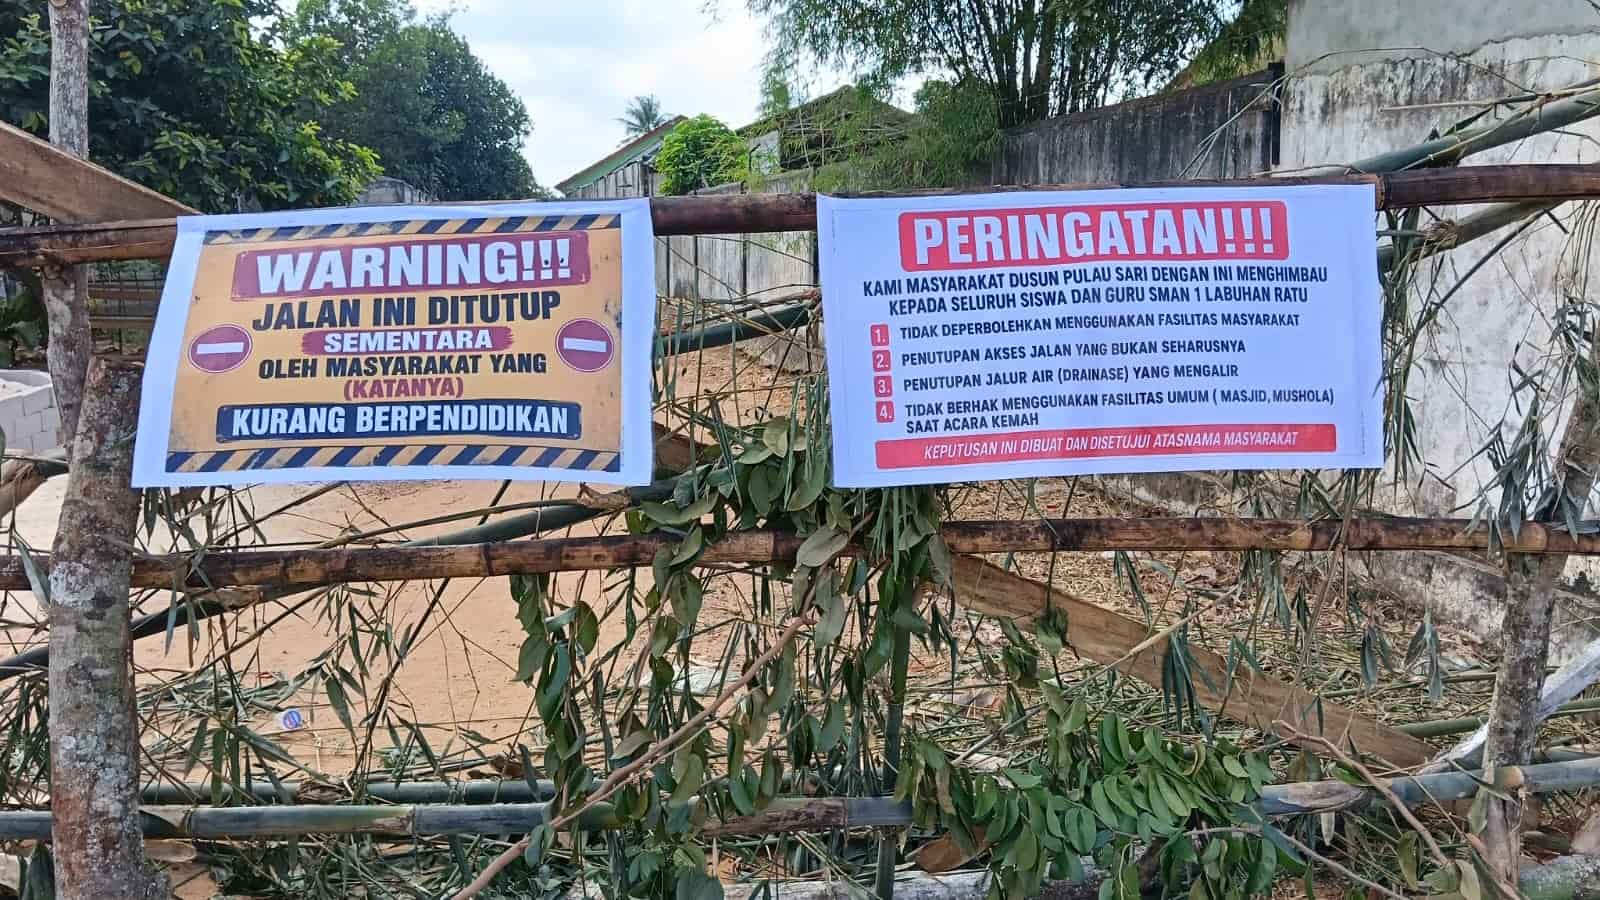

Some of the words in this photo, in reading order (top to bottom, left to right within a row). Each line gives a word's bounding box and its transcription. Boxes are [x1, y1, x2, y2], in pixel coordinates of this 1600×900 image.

[914, 207, 1274, 265] PERINGATAN!!!
[257, 238, 571, 294] WARNING!!!
[863, 279, 902, 296] KAMI
[906, 273, 1005, 294] MASYARAKAT
[1009, 270, 1059, 288] DUSUN
[1063, 266, 1111, 285] PULAU
[1115, 266, 1148, 282] SARI
[1151, 266, 1209, 282] DENGAN
[1213, 265, 1232, 281] INI
[1236, 266, 1327, 283] MENGHIMBAU
[252, 299, 361, 331] JALAN
[373, 296, 415, 326] INI
[429, 291, 560, 323] DITUTUP
[889, 297, 948, 316] KEPADA
[951, 293, 1017, 312] SELURUH
[1020, 290, 1067, 308] SISWA
[1072, 288, 1100, 303] DAN
[1105, 287, 1145, 303] GURU
[1148, 286, 1190, 302] SMAN
[1194, 286, 1200, 301] 1
[1205, 286, 1269, 301] LABUHAN
[1273, 286, 1308, 303] RATU
[324, 330, 492, 352] SEMENTARA
[875, 329, 886, 343] 1.
[900, 325, 938, 339] TIDAK
[941, 318, 1052, 336] DEPERBOLEHKAN
[1055, 314, 1155, 330] MENGGUNAKAN
[1158, 312, 1217, 327] FASILITAS
[1221, 312, 1299, 327] MASYARAKAT
[259, 358, 317, 379] OLEH
[326, 356, 480, 377] MASYARAKAT
[491, 353, 546, 373] YANG
[876, 354, 888, 369] 2.
[902, 349, 980, 367] PENUTUPAN
[985, 345, 1026, 362] AKSES
[1030, 343, 1072, 359] JALAN
[1076, 342, 1107, 357] YANG
[1112, 340, 1158, 355] BUKAN
[1162, 339, 1245, 354] SEHARUSNYA
[344, 377, 464, 401] (KATANYA)
[877, 379, 891, 394] 3.
[903, 374, 981, 392] PENUTUPAN
[985, 370, 1028, 388] JALUR
[1032, 368, 1054, 383] AIR
[1057, 365, 1129, 383] (DRAINASE)
[1133, 364, 1170, 379] YANG
[1174, 364, 1238, 378] MENGALIR
[879, 405, 892, 420] 4.
[905, 402, 943, 417] TIDAK
[947, 397, 998, 414] BERHAK
[1002, 393, 1098, 411] MENGGUNAKAN
[1101, 390, 1163, 405] FASILITAS
[1167, 389, 1209, 404] UMUM
[232, 405, 345, 436] KURANG
[356, 405, 568, 434] BERPENDIDIKAN
[906, 419, 940, 434] SAAT
[944, 416, 988, 431] ACARA
[992, 413, 1039, 428] KEMAH
[924, 442, 998, 459] KEPUTUSAN
[1000, 440, 1018, 454] INI
[1021, 437, 1064, 453] DIBUAT
[1066, 437, 1088, 451] DAN
[1090, 434, 1151, 451] DISETUJUI
[1153, 432, 1221, 449] ATASNAMA
[1224, 431, 1298, 447] MASYARAKAT
